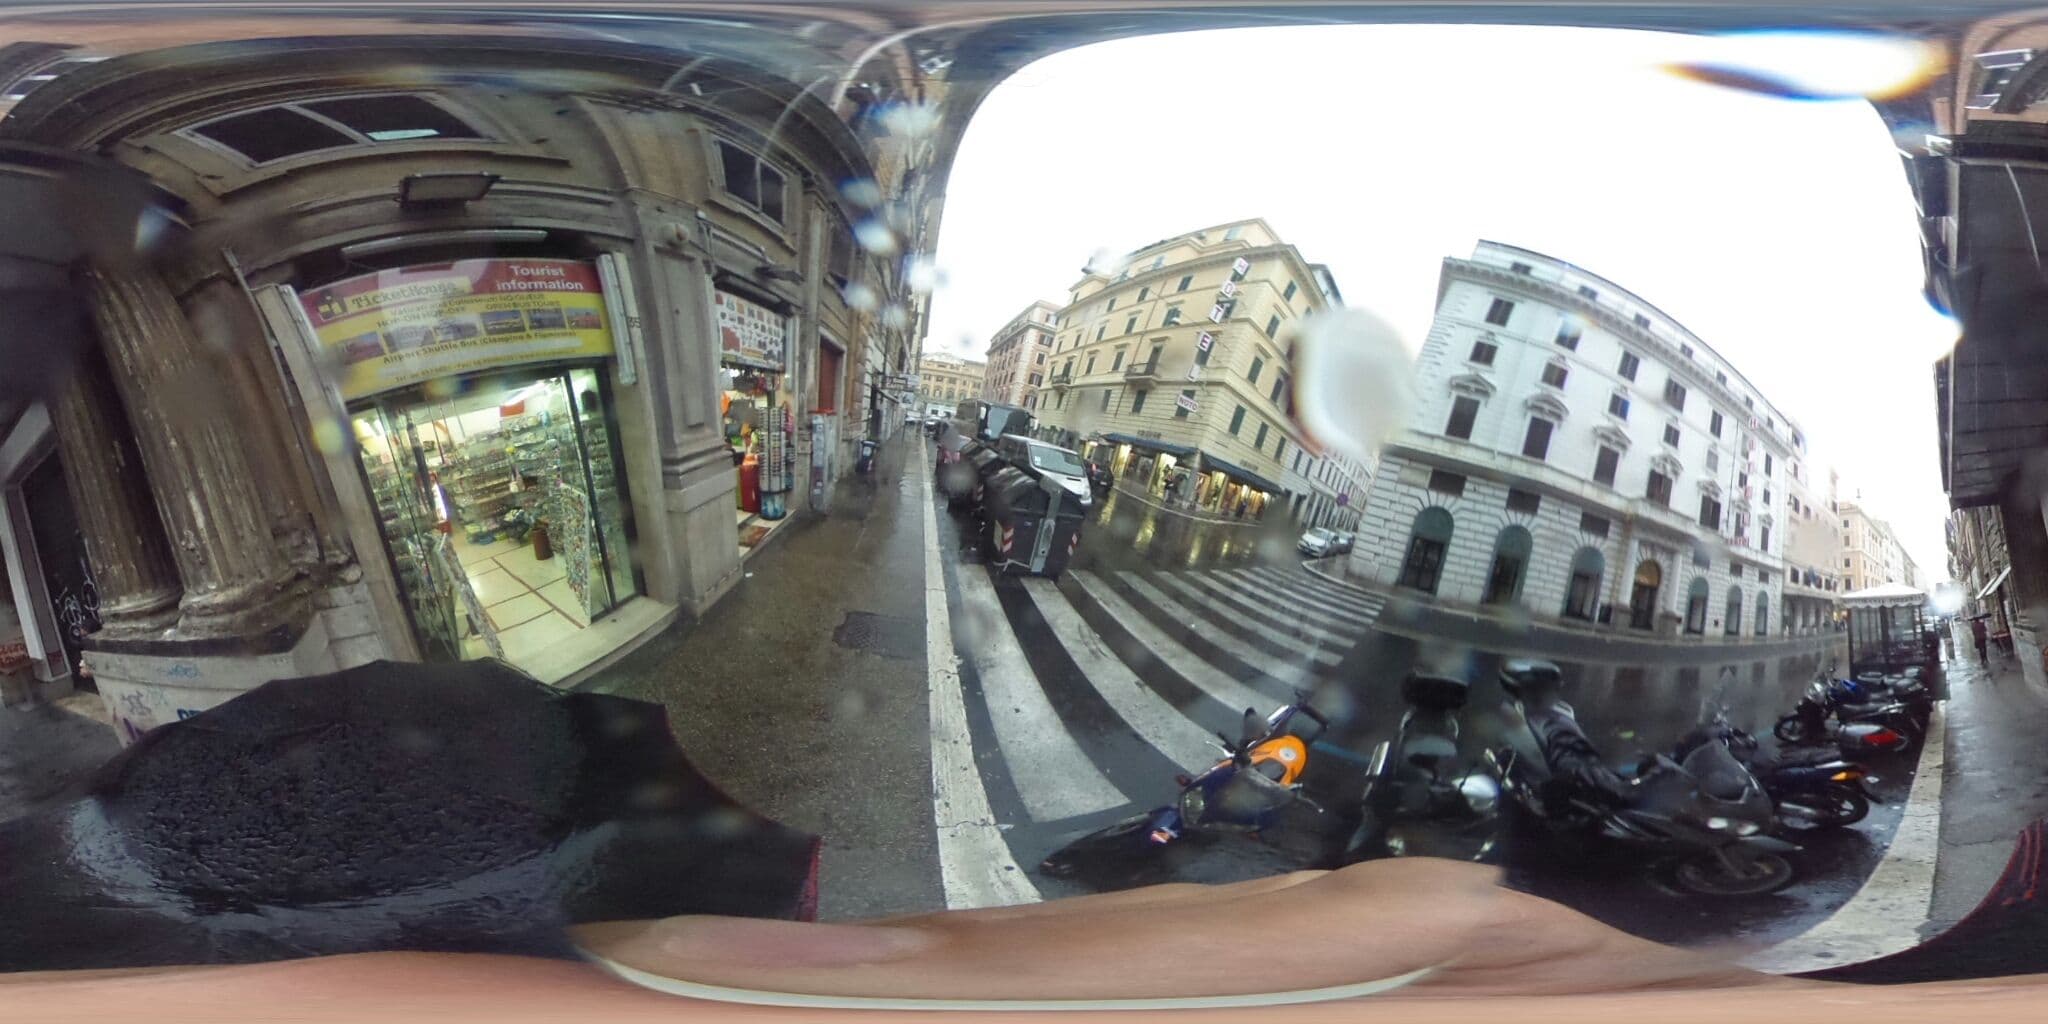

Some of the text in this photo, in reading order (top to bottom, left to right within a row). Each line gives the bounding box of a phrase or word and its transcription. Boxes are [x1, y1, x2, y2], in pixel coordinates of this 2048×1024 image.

[510, 265, 565, 277] Tourist
[496, 279, 584, 291] information
[1188, 258, 1248, 382] HOTEL
